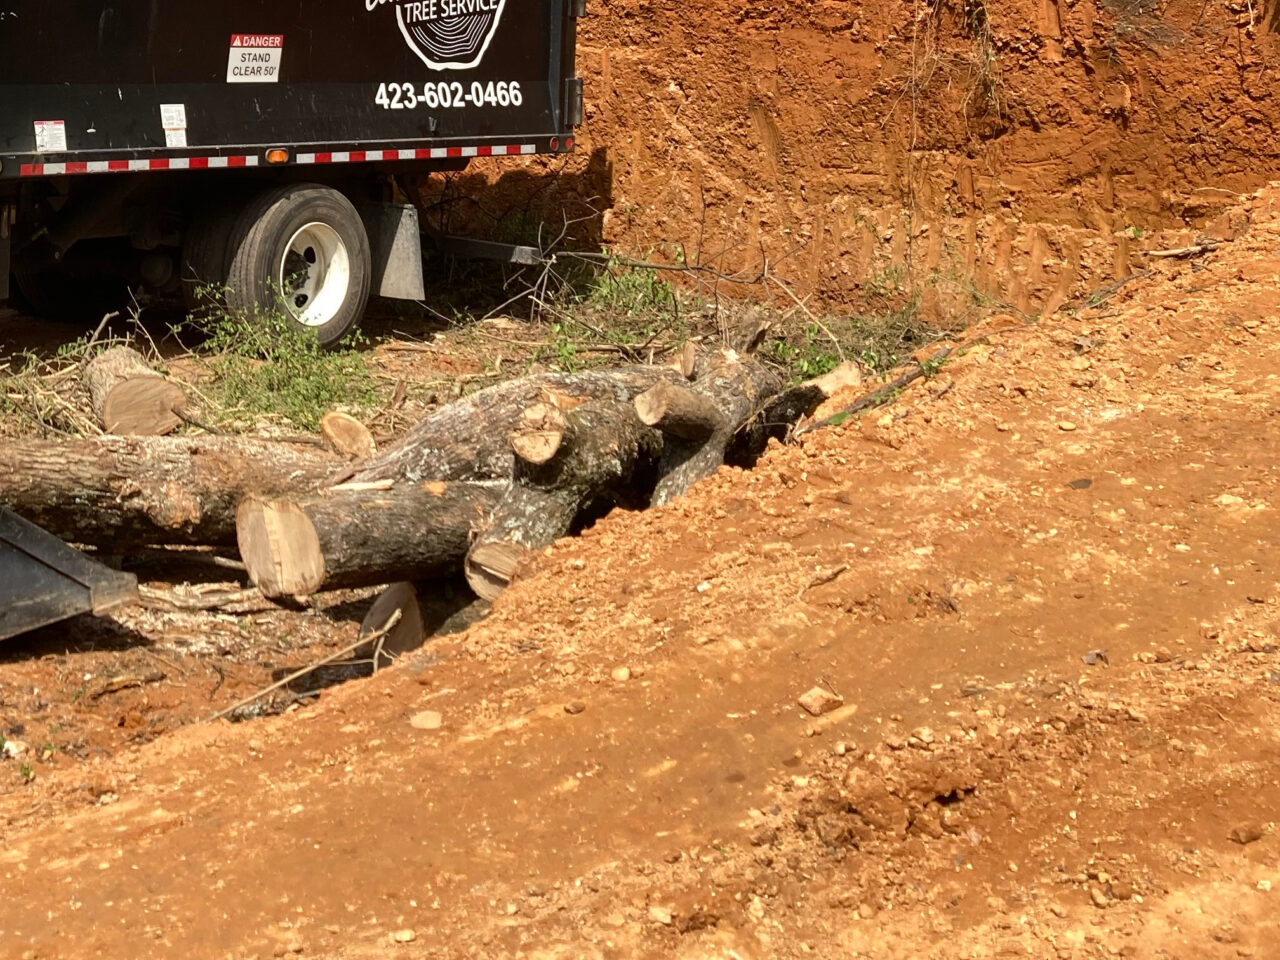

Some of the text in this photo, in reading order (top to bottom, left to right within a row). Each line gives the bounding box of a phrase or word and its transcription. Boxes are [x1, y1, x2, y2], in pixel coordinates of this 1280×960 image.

[404, 0, 438, 24] TREE
[242, 36, 281, 47] DANGER
[240, 52, 271, 63] STAND
[232, 66, 262, 76] CLEAR
[374, 80, 523, 110] 423-602-0466
